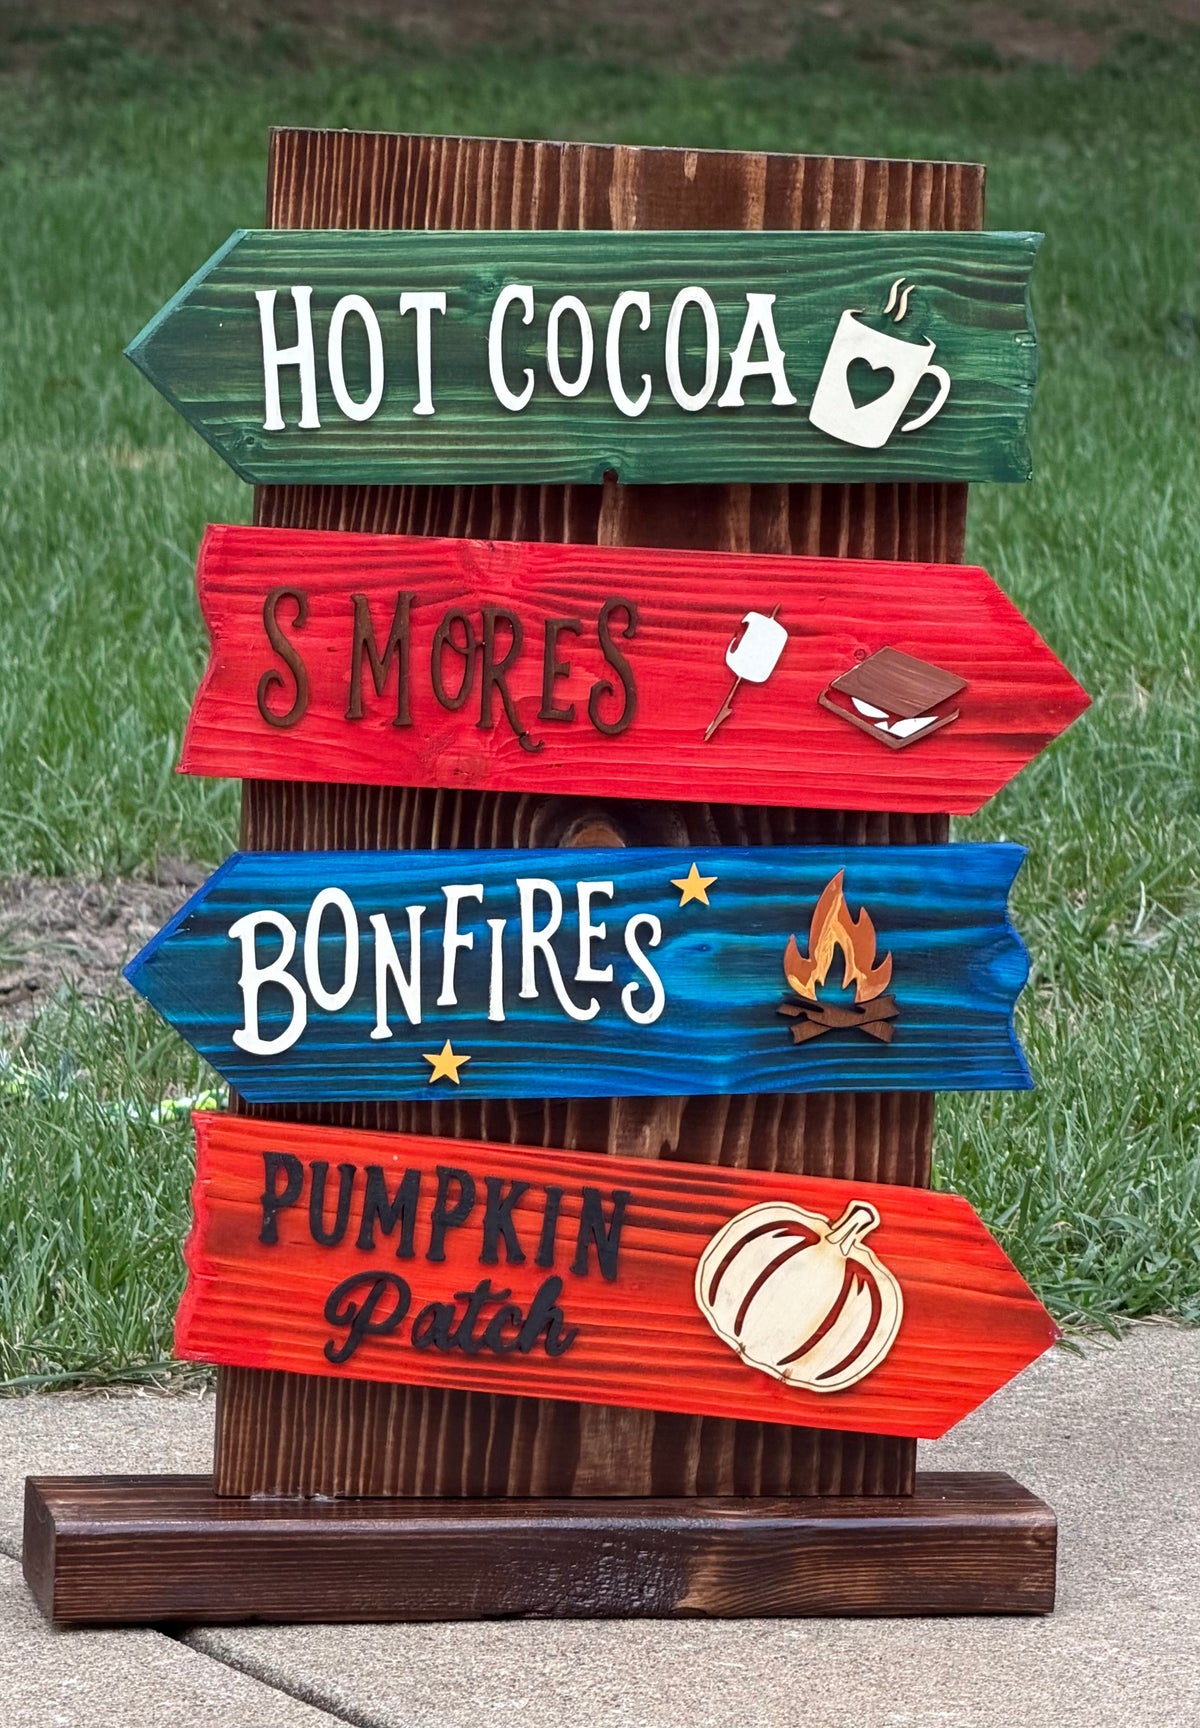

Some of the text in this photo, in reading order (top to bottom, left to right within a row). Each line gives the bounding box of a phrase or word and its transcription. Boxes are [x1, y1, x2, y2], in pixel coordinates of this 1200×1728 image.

[255, 284, 797, 430] HOT COCOA
[227, 878, 665, 1055] BONFIRES
[258, 1151, 631, 1281] PUMPKIN
[323, 1270, 580, 1363] Patch
